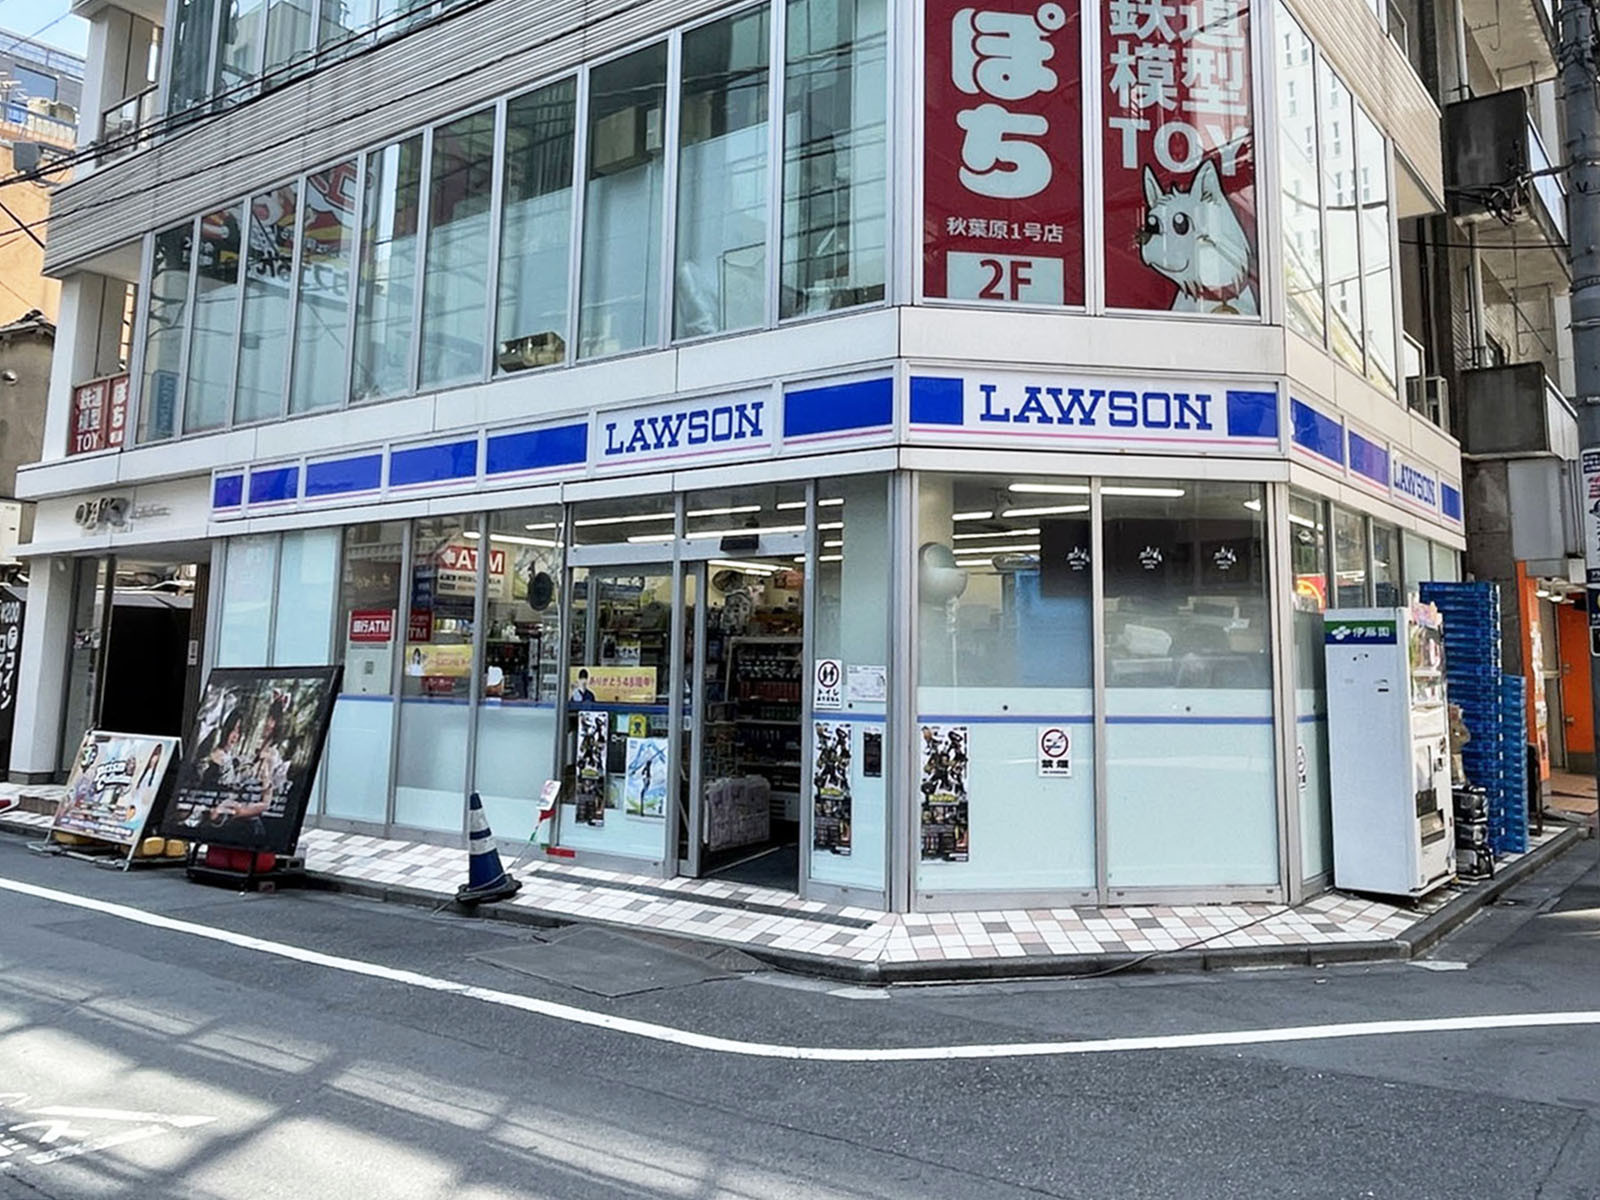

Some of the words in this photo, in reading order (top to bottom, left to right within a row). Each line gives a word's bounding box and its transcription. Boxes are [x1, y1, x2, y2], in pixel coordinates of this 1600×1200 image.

[1109, 0, 1246, 48] 鉄道
[1109, 40, 1248, 116] 模型
[1108, 116, 1252, 177] TOY
[946, 216, 1064, 244] 秋葉原1号店
[978, 259, 1033, 300] 2F
[605, 401, 764, 456] LAWSON
[980, 384, 1213, 431] LAWSON
[76, 432, 100, 452] TOY
[1393, 459, 1436, 506] LAWSON
